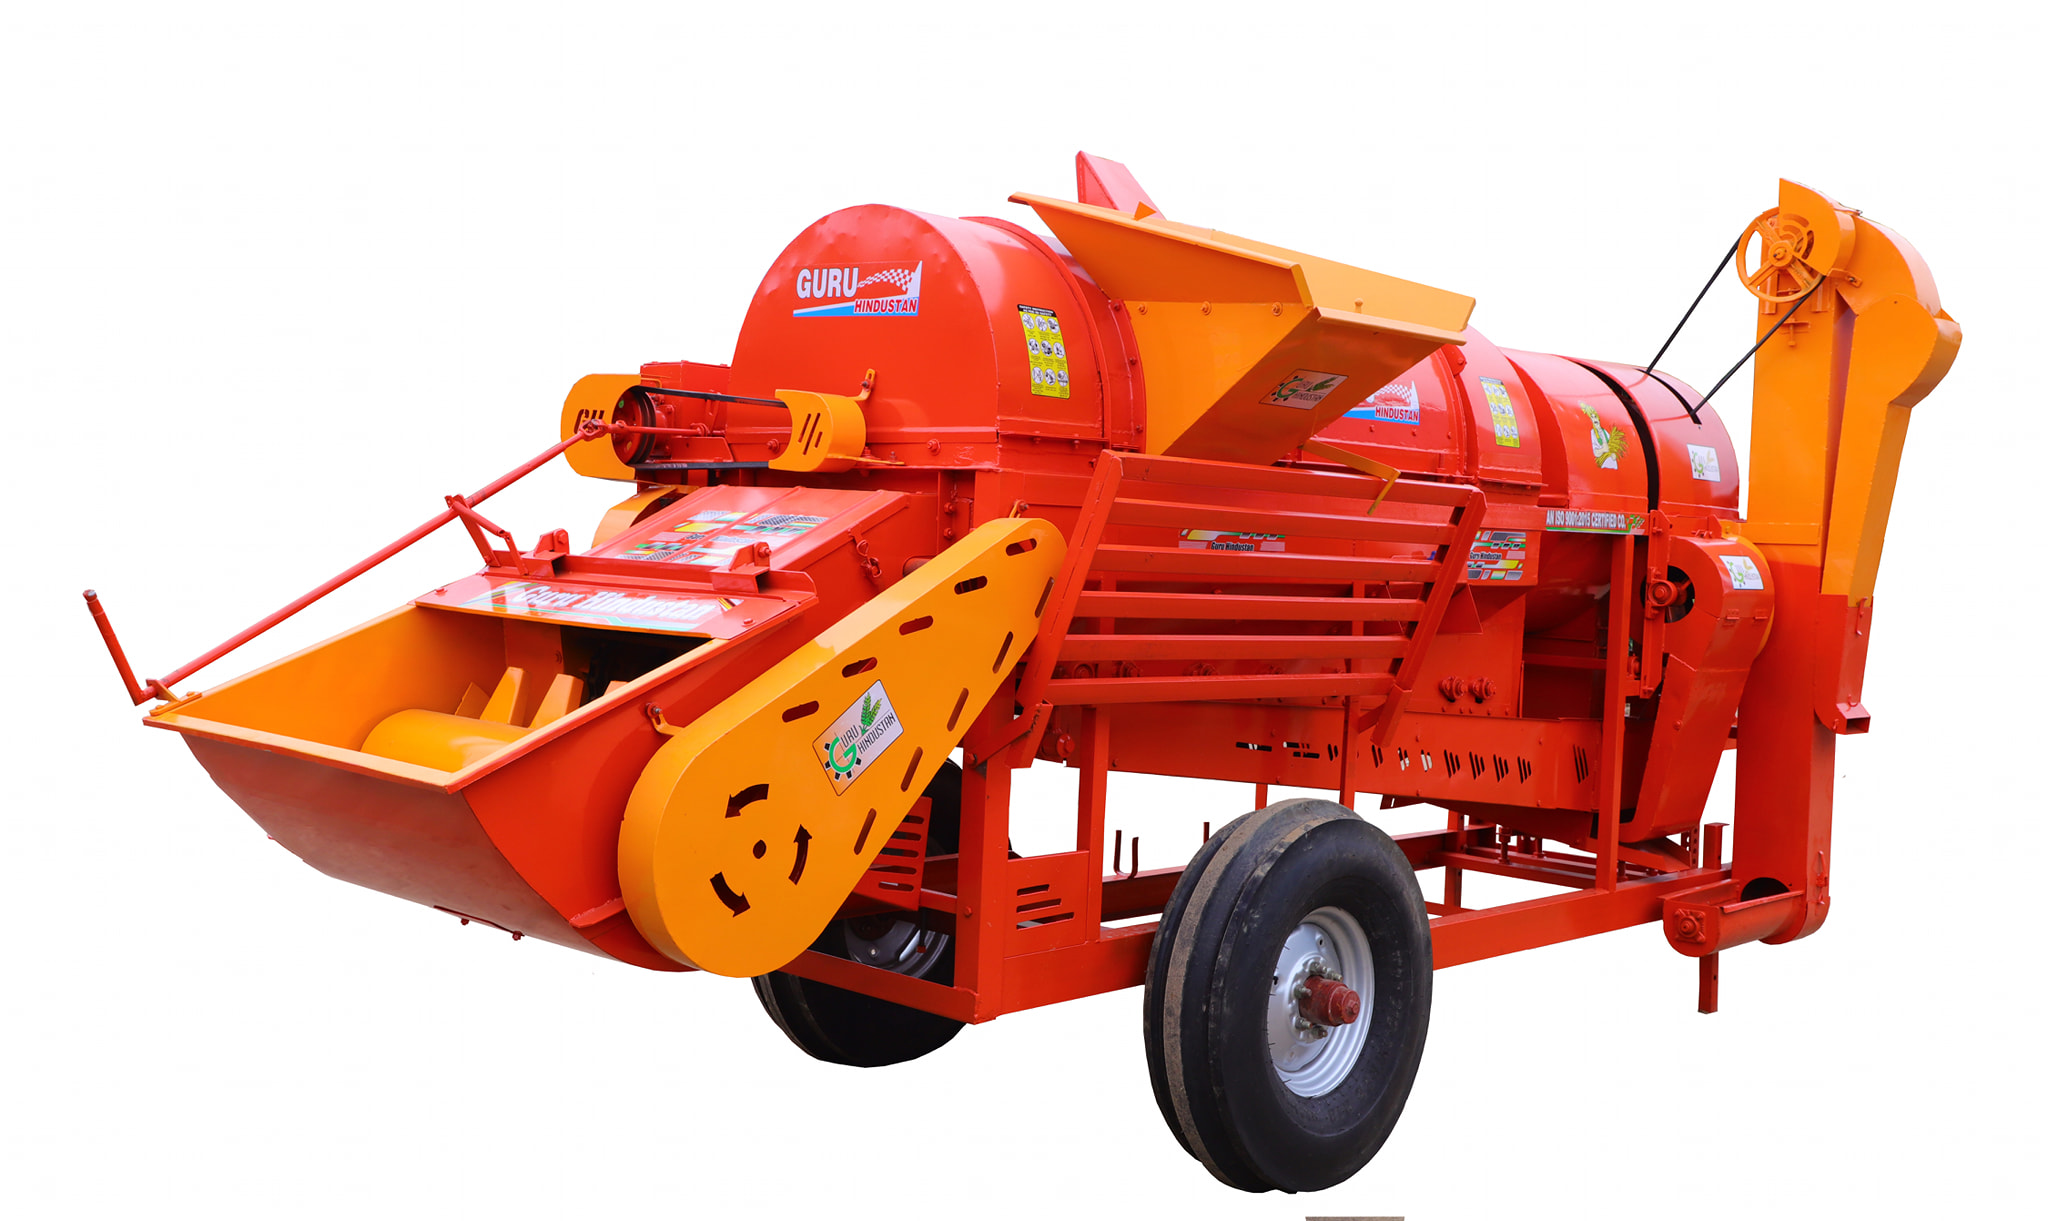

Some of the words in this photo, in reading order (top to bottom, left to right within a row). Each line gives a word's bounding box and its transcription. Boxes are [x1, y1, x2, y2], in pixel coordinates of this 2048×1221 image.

[796, 267, 859, 299] GURU
[854, 299, 918, 314] HINDUSTAN
[1375, 406, 1419, 422] HINDUSTAN
[1546, 510, 1555, 526] AN
[1555, 510, 1565, 526] ISO
[1591, 512, 1617, 528] CERTIFIED
[1211, 541, 1225, 551] Guru
[1225, 542, 1254, 552] Hindustan
[857, 711, 897, 755] HINDUSTAN
